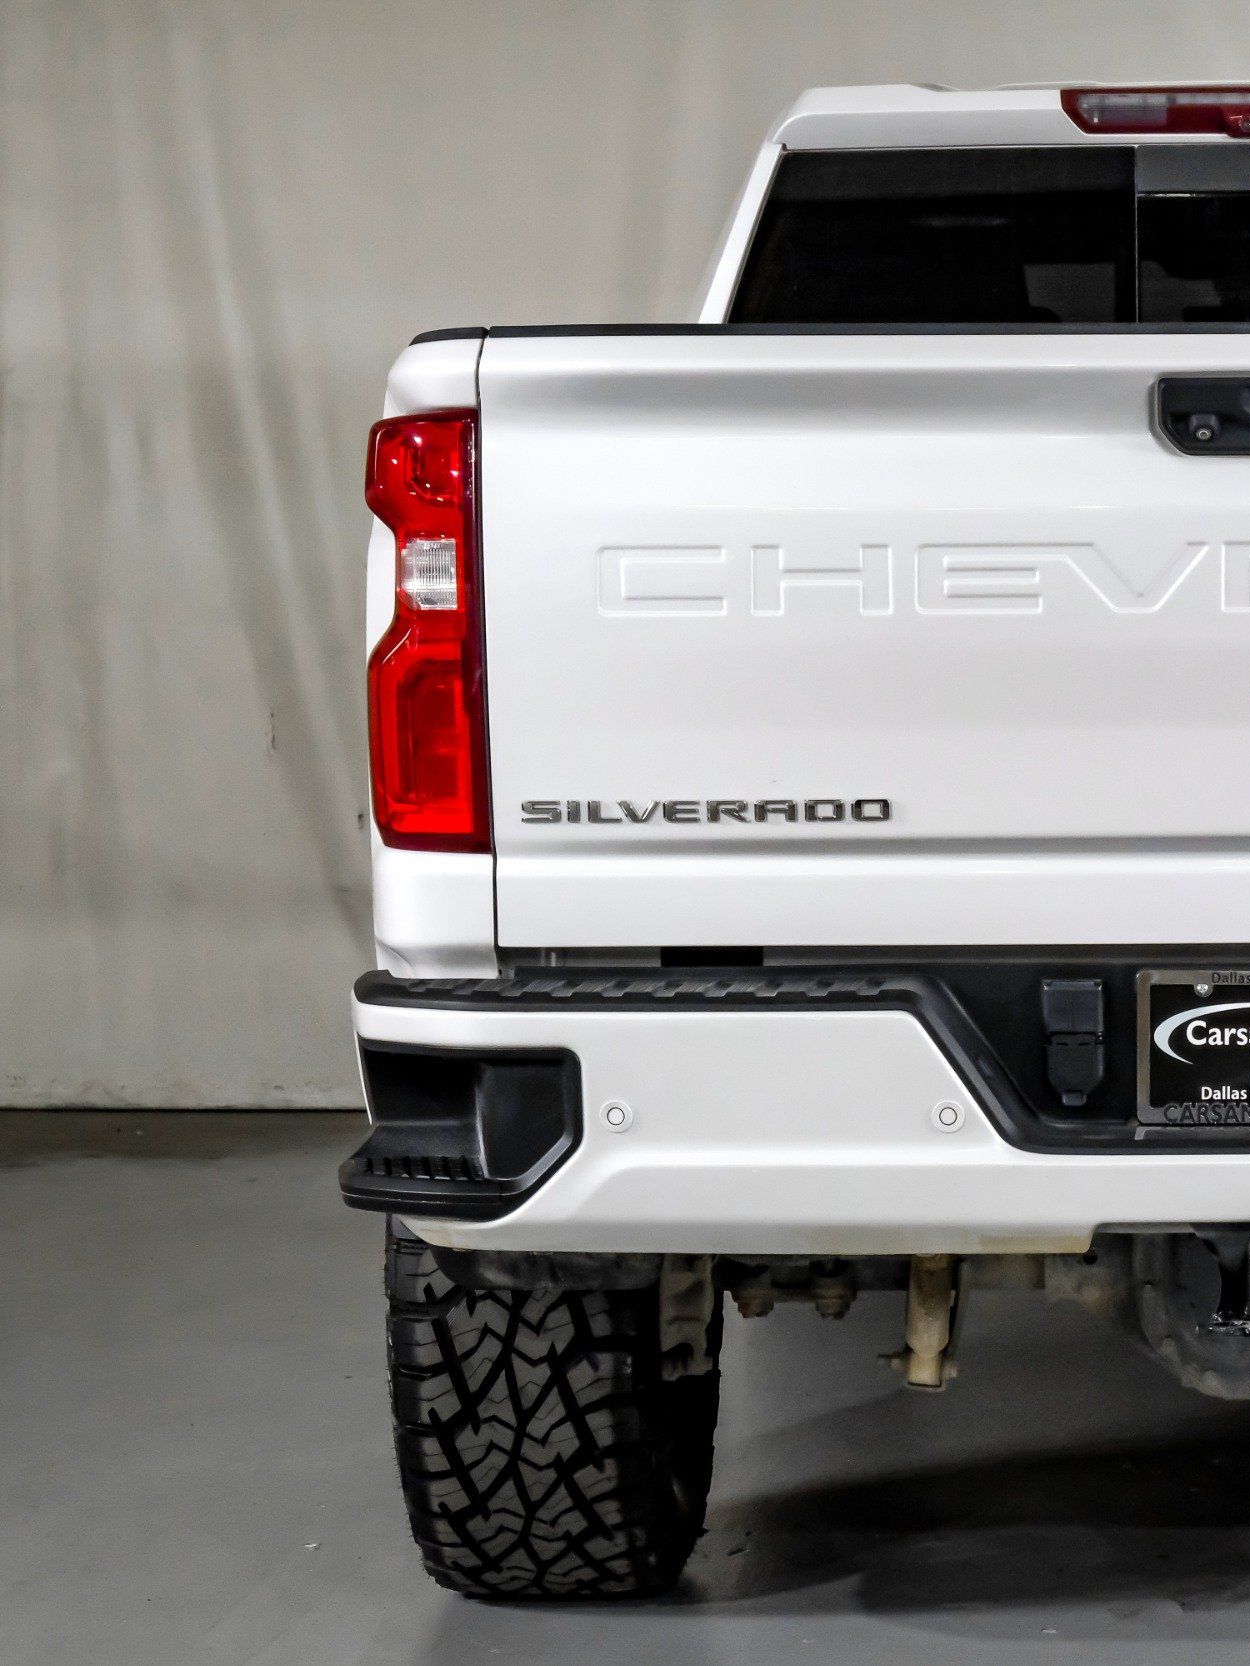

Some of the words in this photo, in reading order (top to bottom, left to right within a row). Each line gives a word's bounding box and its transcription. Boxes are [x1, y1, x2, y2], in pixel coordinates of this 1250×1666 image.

[520, 799, 892, 824] SILVERADO
[1211, 972, 1250, 984] Dallas
[1201, 1085, 1248, 1100] Dallas
